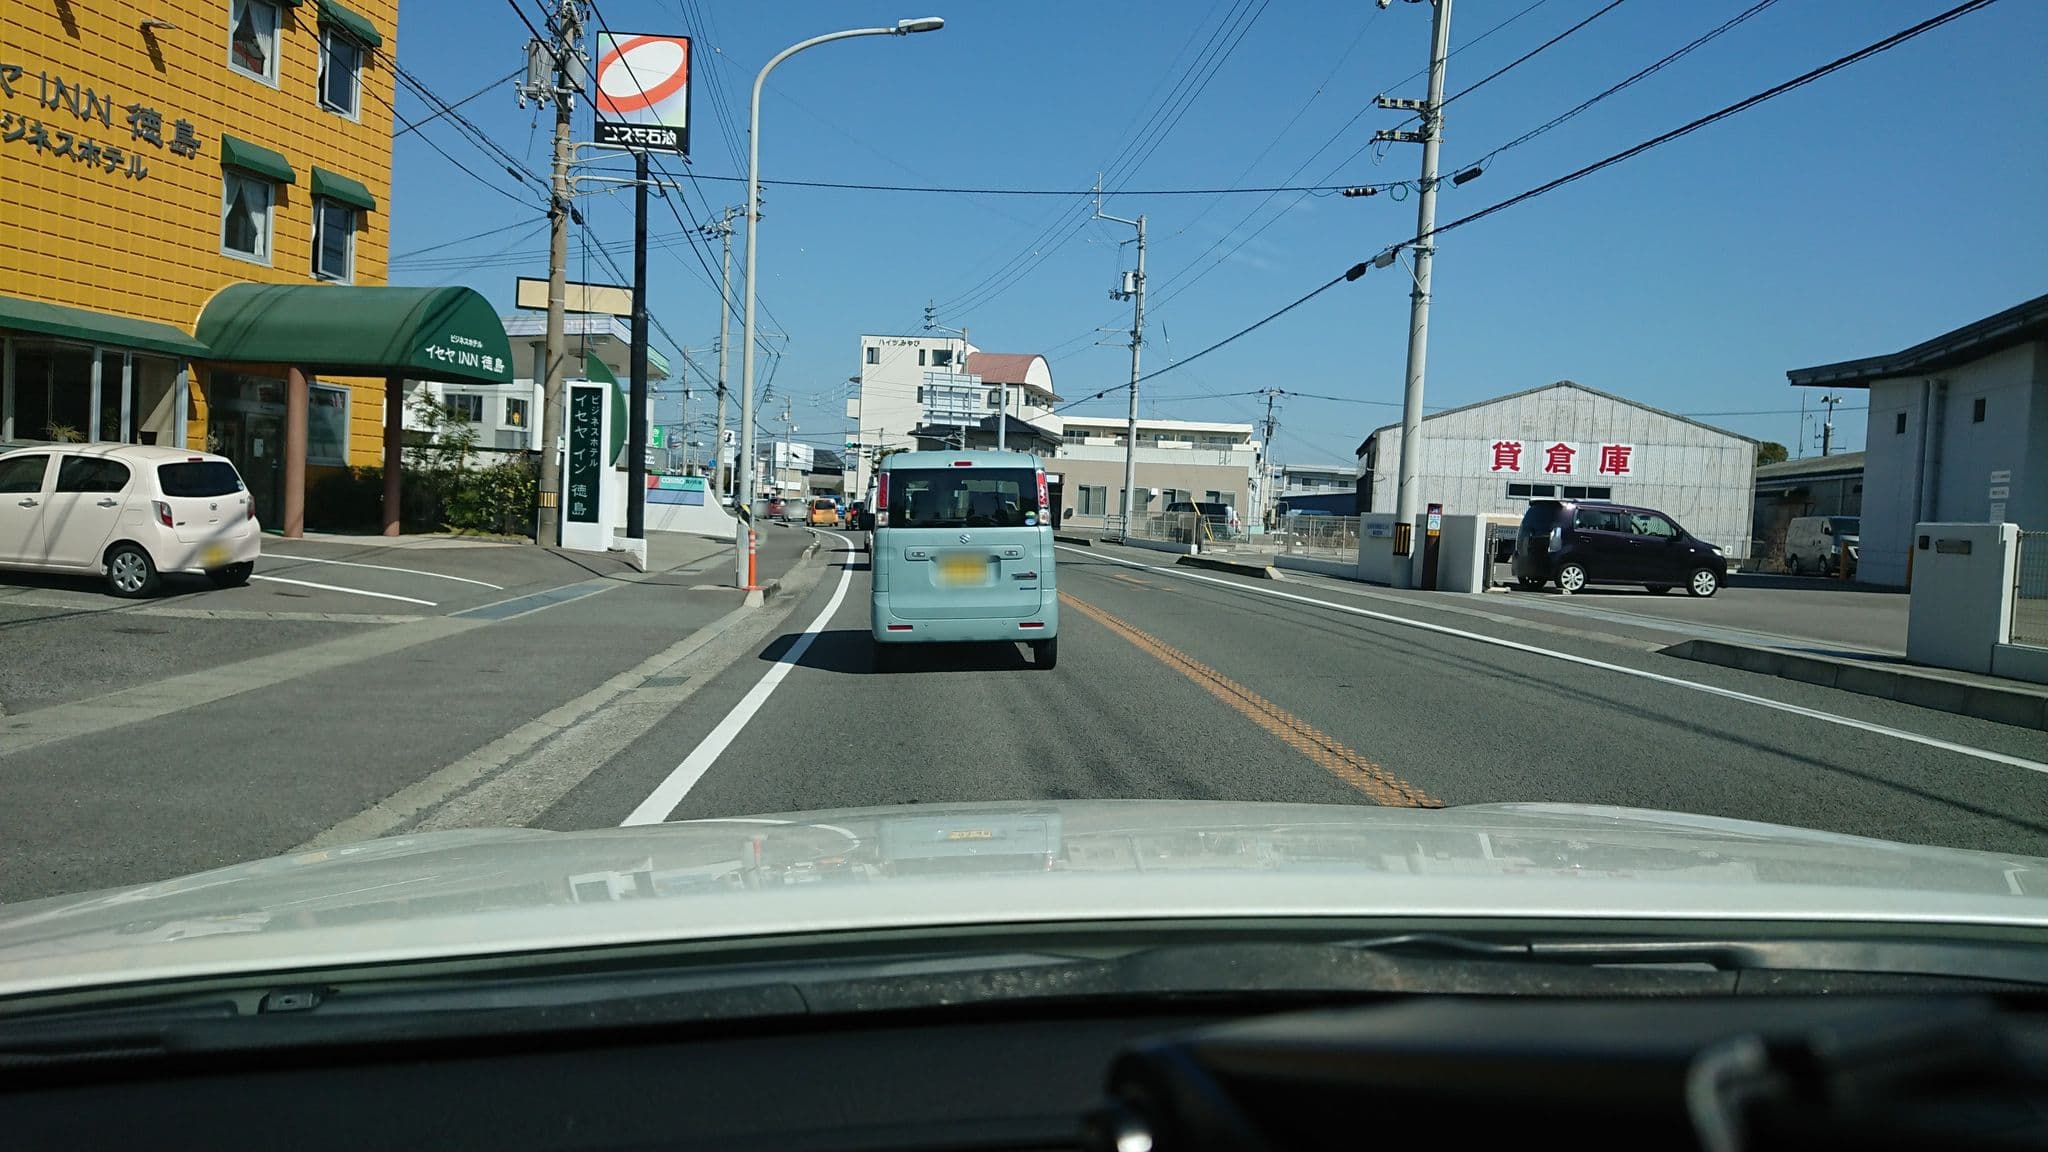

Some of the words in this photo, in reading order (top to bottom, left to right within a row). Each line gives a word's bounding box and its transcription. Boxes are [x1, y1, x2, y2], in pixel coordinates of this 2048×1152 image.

[40, 70, 111, 129] INN
[126, 103, 202, 160] 徳島
[604, 125, 677, 145] コスモ石油
[450, 334, 483, 349] ビジネスホテル
[425, 344, 456, 363] イセヤ
[458, 350, 479, 368] INN
[481, 354, 505, 373] 徳島
[574, 394, 588, 439] イセヤ
[589, 394, 600, 467] ビジネスホテル
[573, 447, 586, 474] イン
[1492, 441, 1632, 476] 貸倉庫
[571, 483, 588, 516] 徳島
